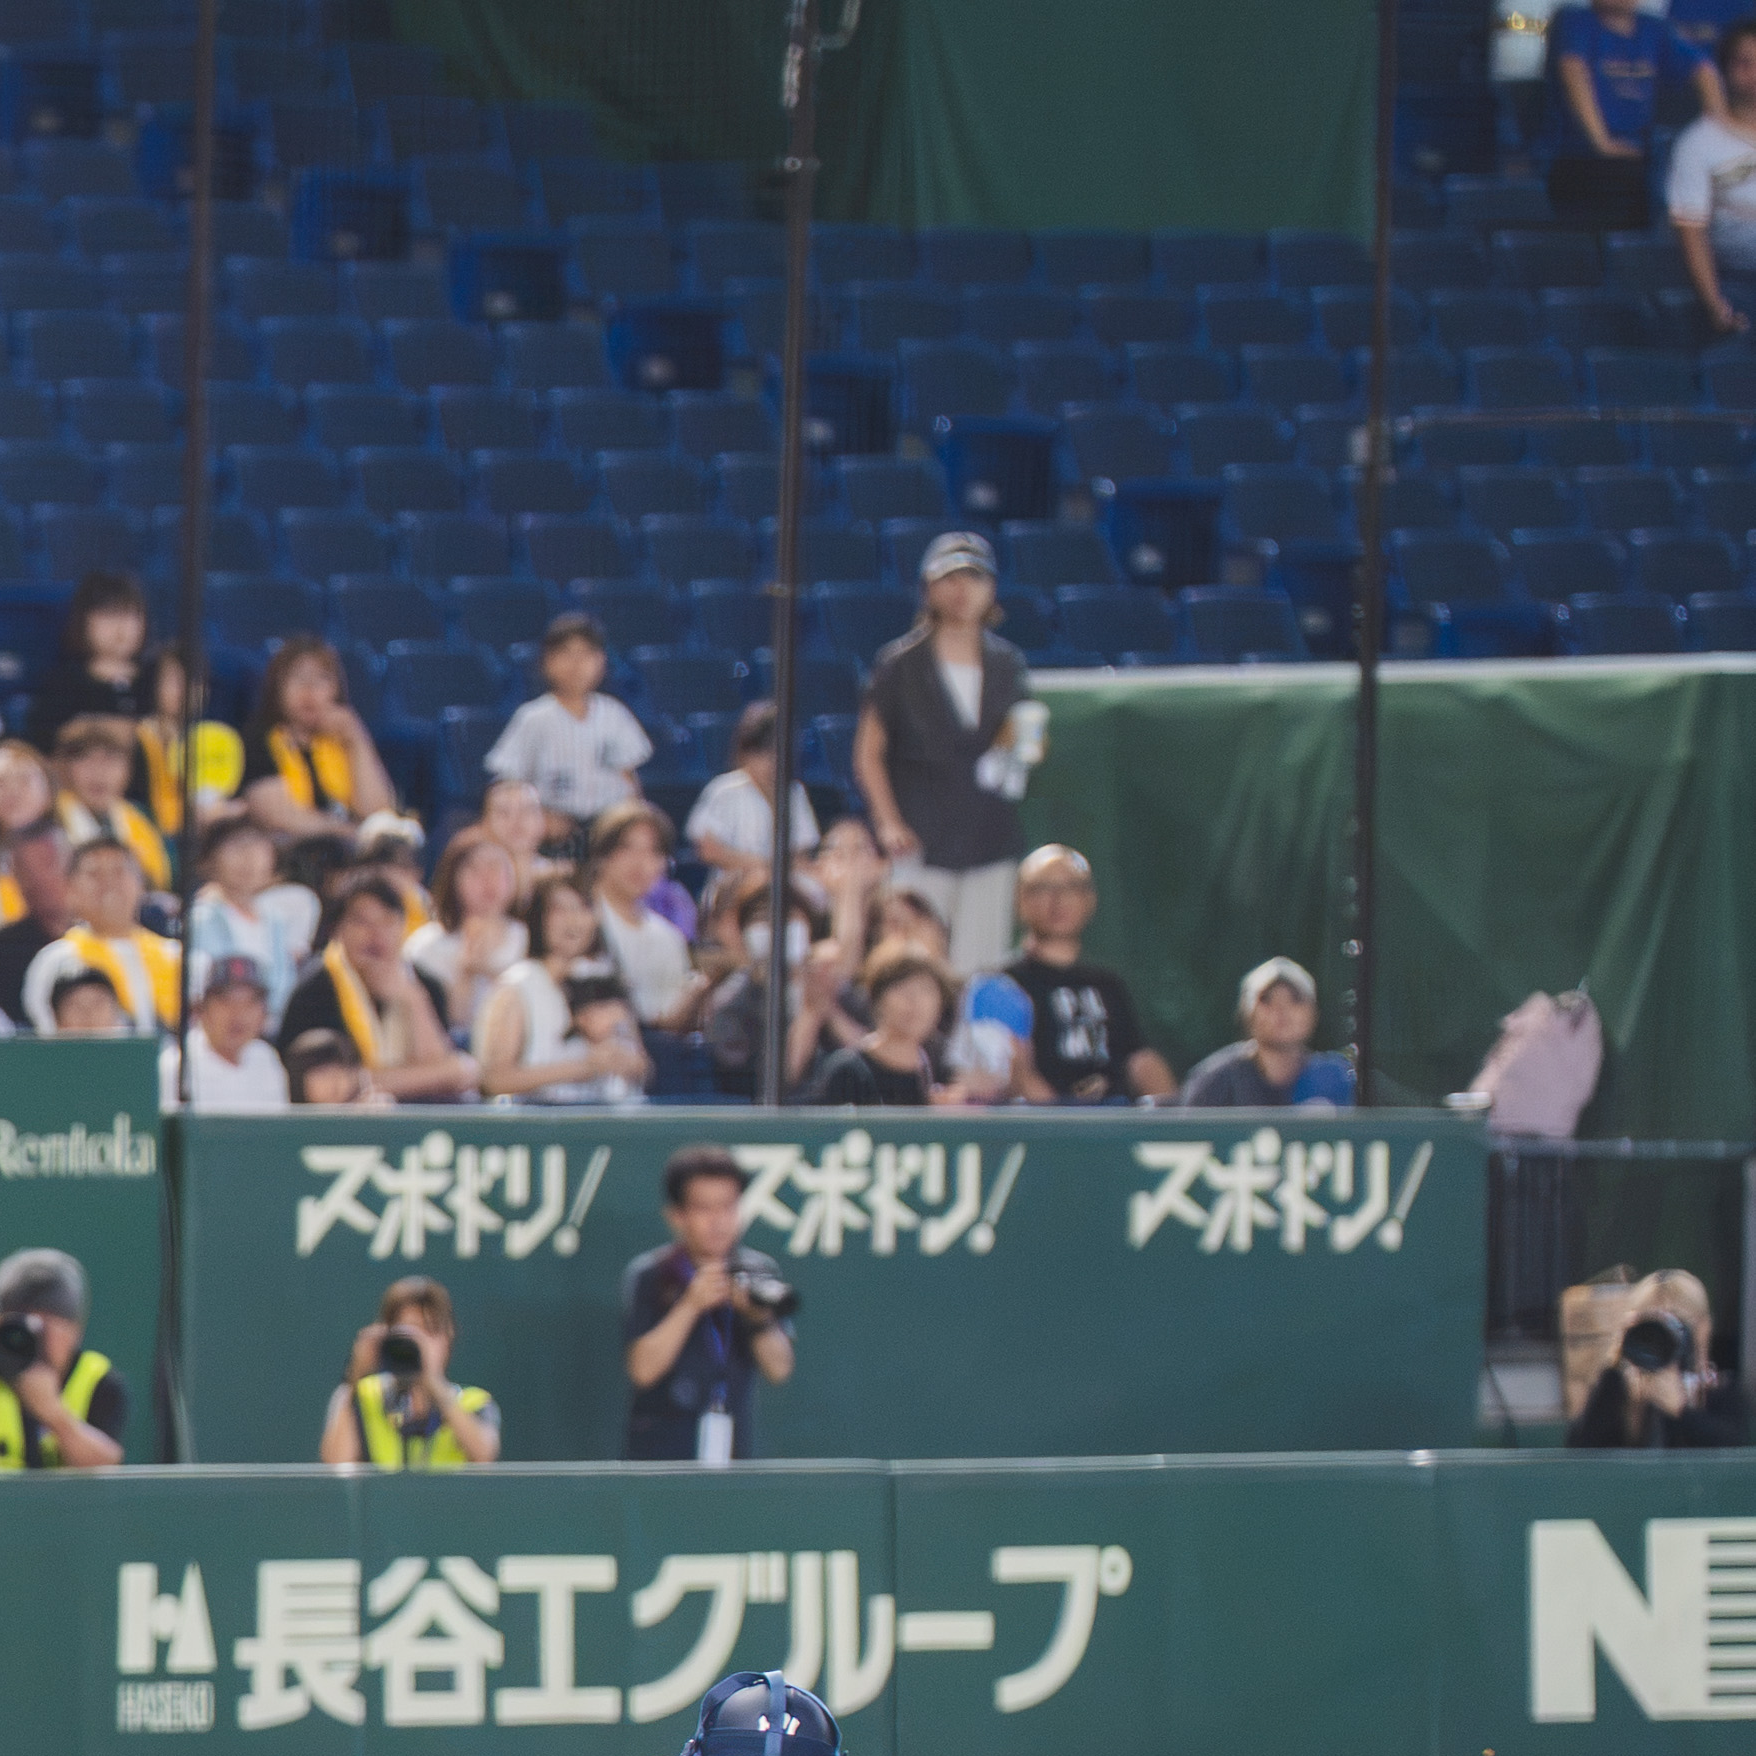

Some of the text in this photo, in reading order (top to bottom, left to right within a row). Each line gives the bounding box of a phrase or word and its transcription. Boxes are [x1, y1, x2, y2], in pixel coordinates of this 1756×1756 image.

[295, 1129, 611, 1260] スポドリ!
[733, 1129, 1027, 1257] スポドリ!
[1127, 1126, 1435, 1254] スポドリ!
[232, 1544, 1132, 1732] 長谷工グループ
